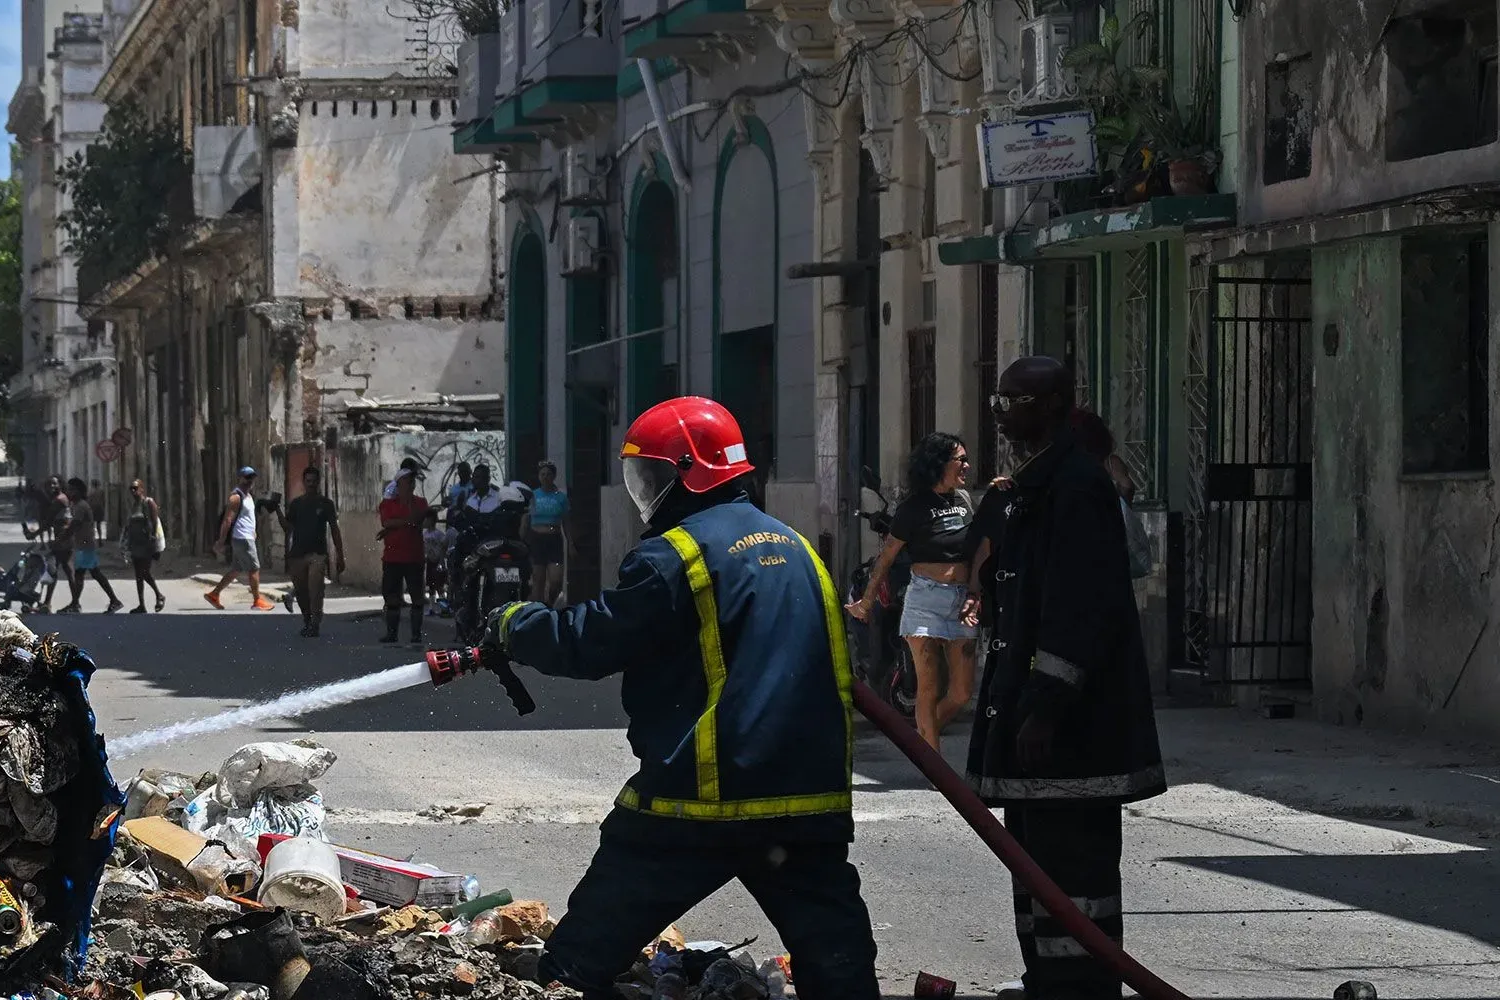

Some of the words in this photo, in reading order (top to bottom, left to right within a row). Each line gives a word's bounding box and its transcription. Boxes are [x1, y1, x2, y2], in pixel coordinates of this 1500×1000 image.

[1026, 152, 1074, 166] Rent
[998, 159, 1085, 177] Rooms
[758, 555, 787, 566] CUBA
